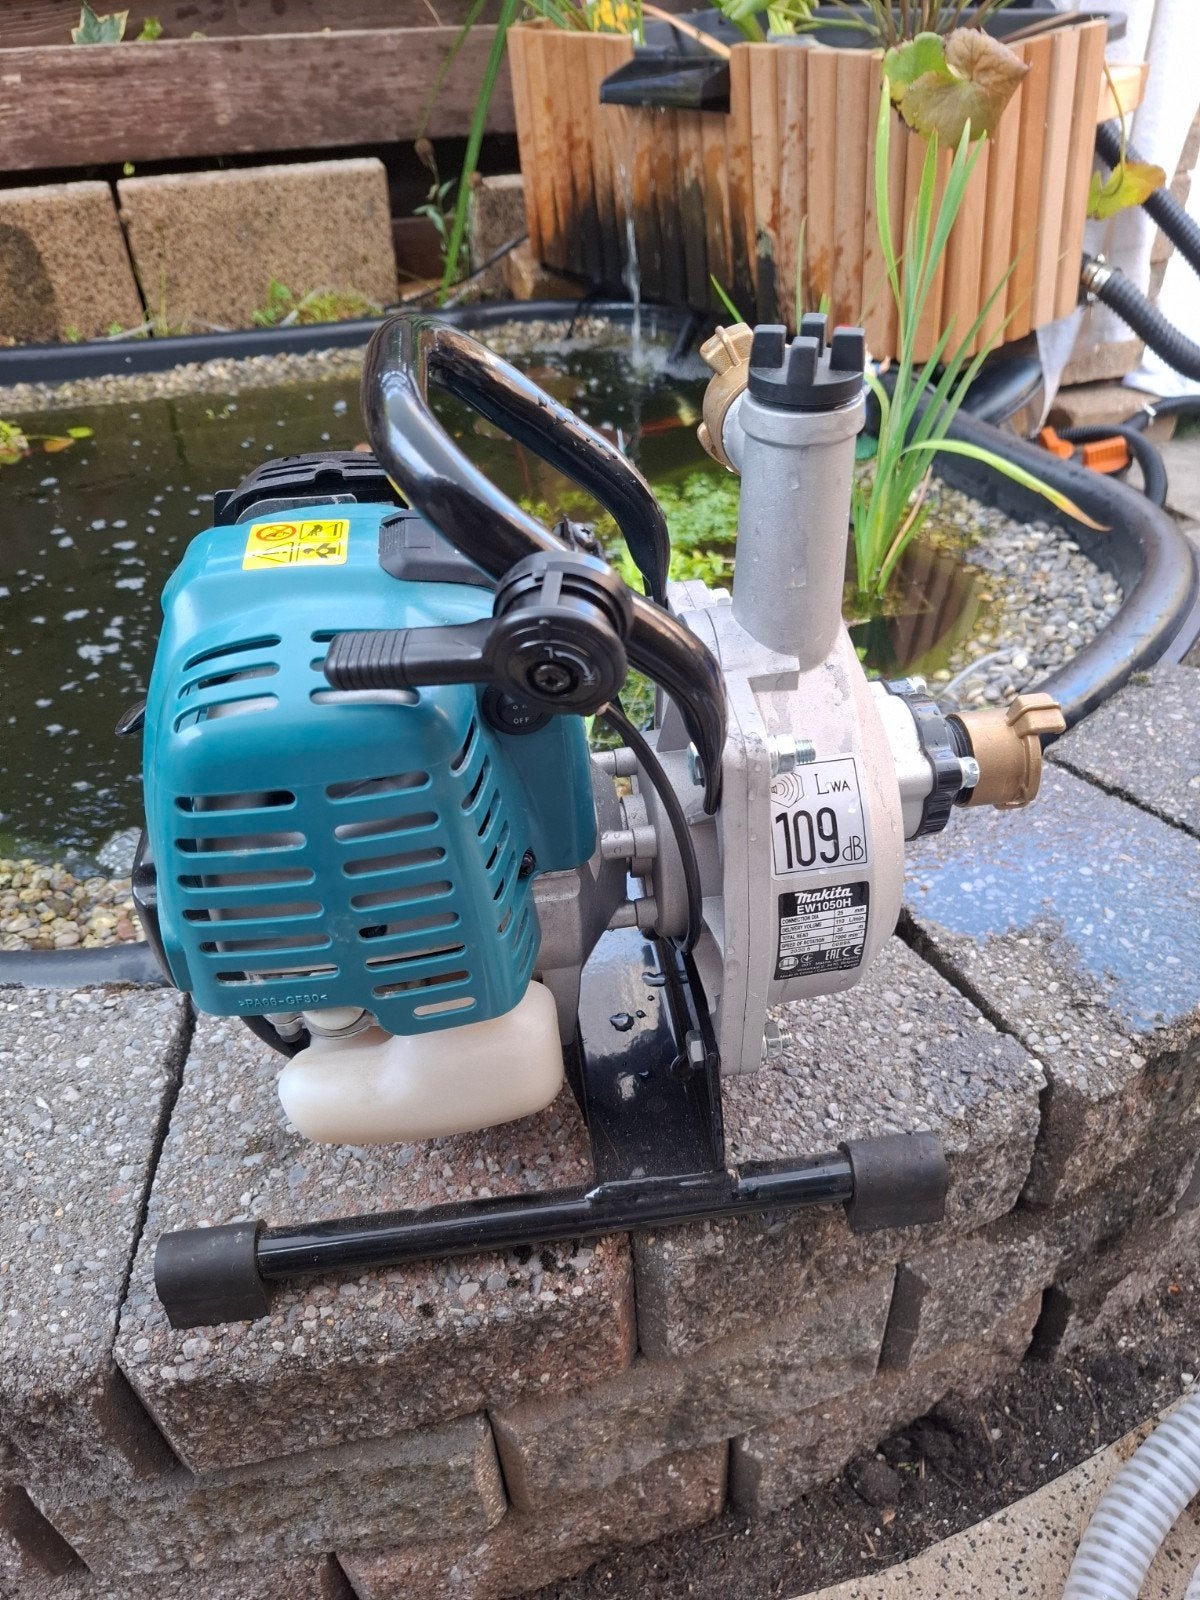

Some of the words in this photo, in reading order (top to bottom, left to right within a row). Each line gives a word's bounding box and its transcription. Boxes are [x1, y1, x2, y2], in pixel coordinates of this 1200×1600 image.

[775, 807, 840, 869] 109
[842, 835, 864, 861] dB
[794, 886, 853, 904] Makita
[796, 898, 852, 915] EW1050H
[781, 915, 811, 925] CONNECTION
